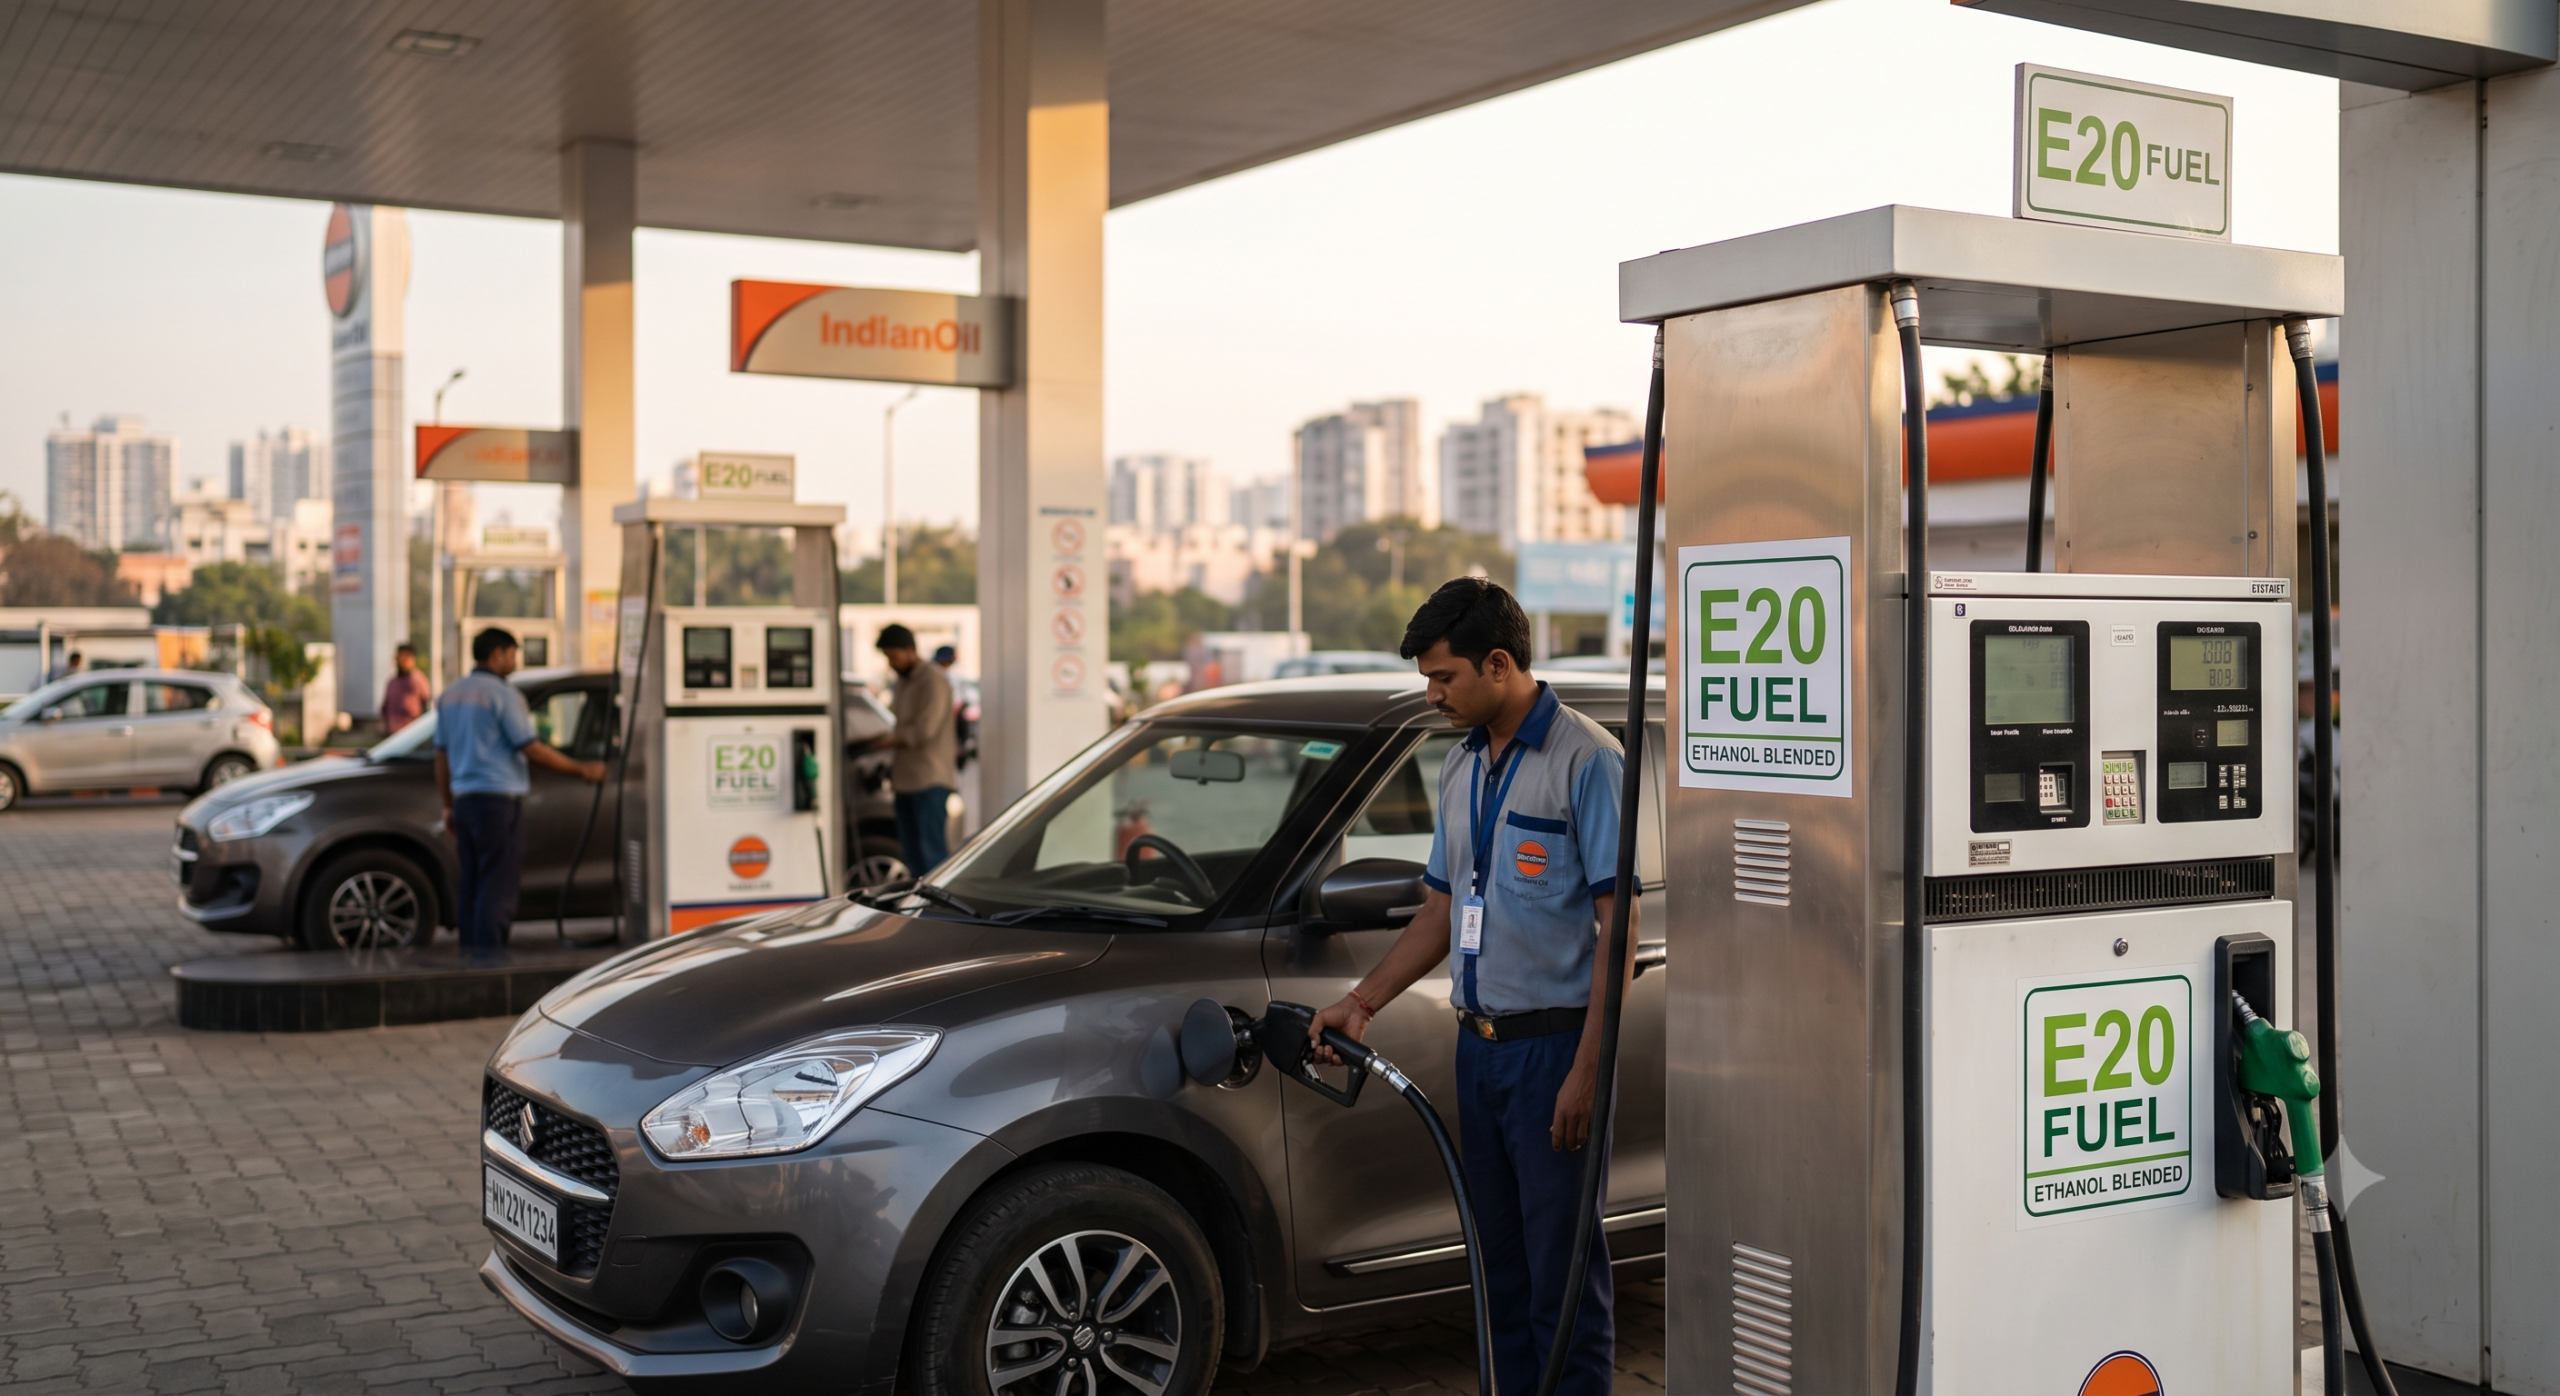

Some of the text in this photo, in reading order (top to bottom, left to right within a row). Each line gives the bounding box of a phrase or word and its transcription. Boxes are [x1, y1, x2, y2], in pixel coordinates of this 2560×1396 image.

[2037, 106, 2220, 191] E20 FUEL
[820, 311, 981, 355] IndianOil
[704, 462, 752, 489] E20
[1700, 585, 1827, 665] E20
[1700, 676, 1827, 723] FUEL
[715, 745, 776, 772] E20
[1691, 744, 1836, 767] ETHANOL BLENDED
[715, 773, 776, 789] FUEL
[2043, 1004, 2175, 1098] E20
[2043, 1096, 2176, 1158] FUEL
[2034, 1165, 2183, 1203] ETHANOL BLENDED
